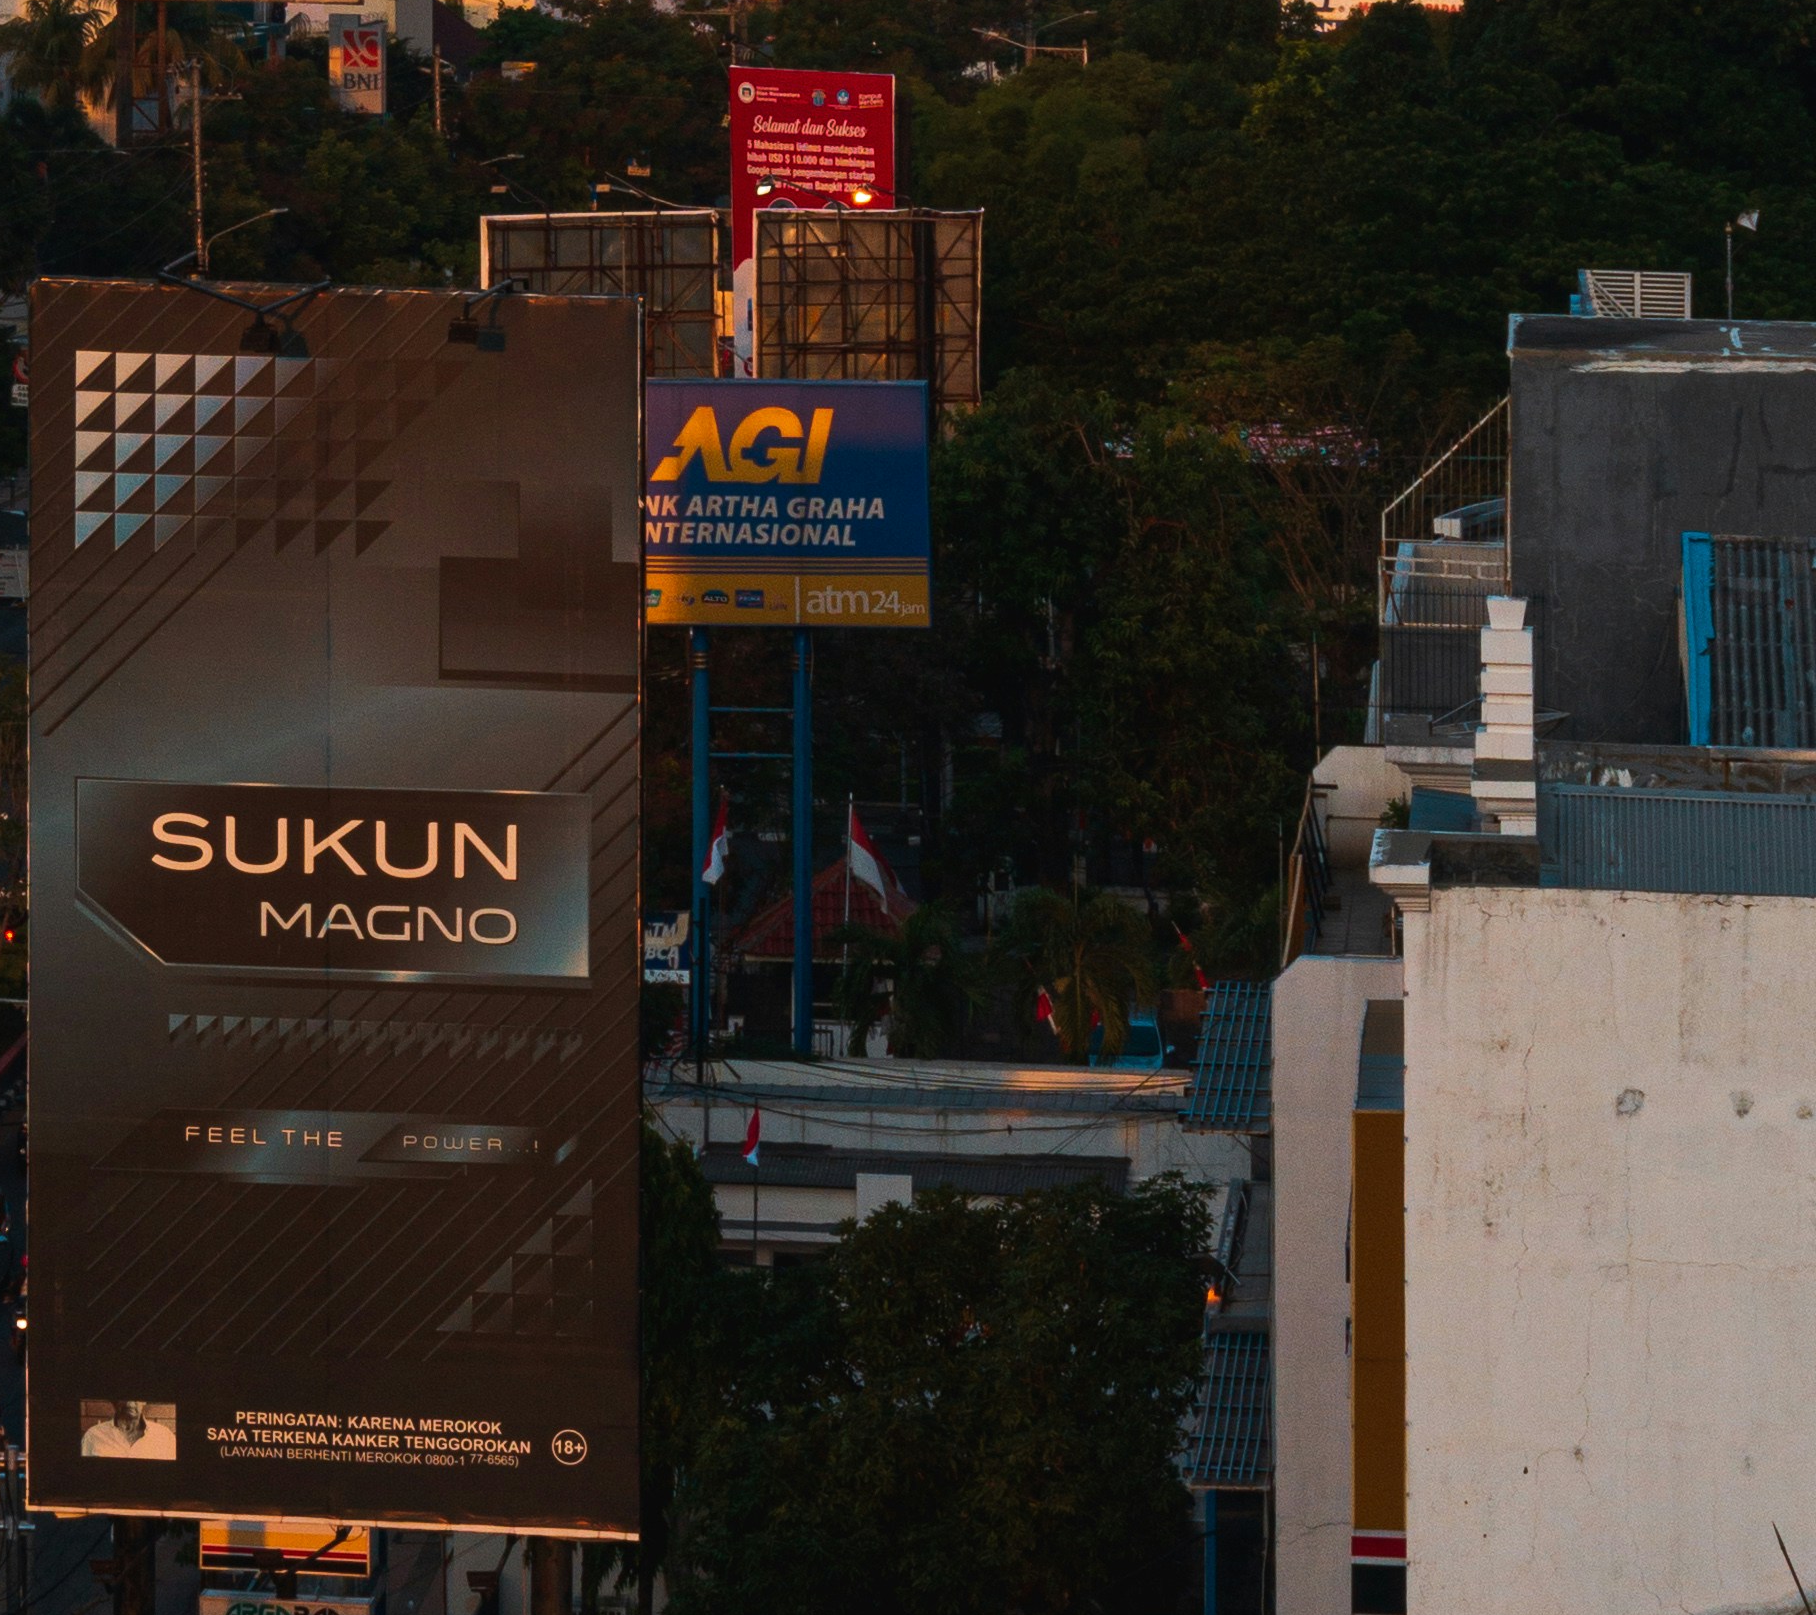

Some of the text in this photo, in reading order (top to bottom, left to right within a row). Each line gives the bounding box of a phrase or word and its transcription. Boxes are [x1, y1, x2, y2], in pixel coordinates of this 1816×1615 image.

[345, 73, 379, 90] BNI
[752, 114, 867, 138] Selamat dan Sukses
[650, 406, 834, 484] AGI
[645, 495, 885, 519] NK ARTHA GRAHA
[645, 522, 856, 547] NTERNASIONAL
[703, 595, 728, 603] ALTO
[151, 812, 517, 881] SUKUN
[259, 901, 517, 945] MAGNO
[185, 1126, 267, 1145] FEEL
[281, 1129, 343, 1147] THE
[236, 1411, 503, 1435] PERINGATAN: KARENA MEROKOK
[207, 1427, 531, 1454] SAYA TERKENA KANKER TENGGOROKAN
[555, 1440, 584, 1455] 18+
[220, 1445, 283, 1459] (LAYANAN
[286, 1448, 352, 1462] BERHENTI
[355, 1452, 422, 1465] MEROKOK
